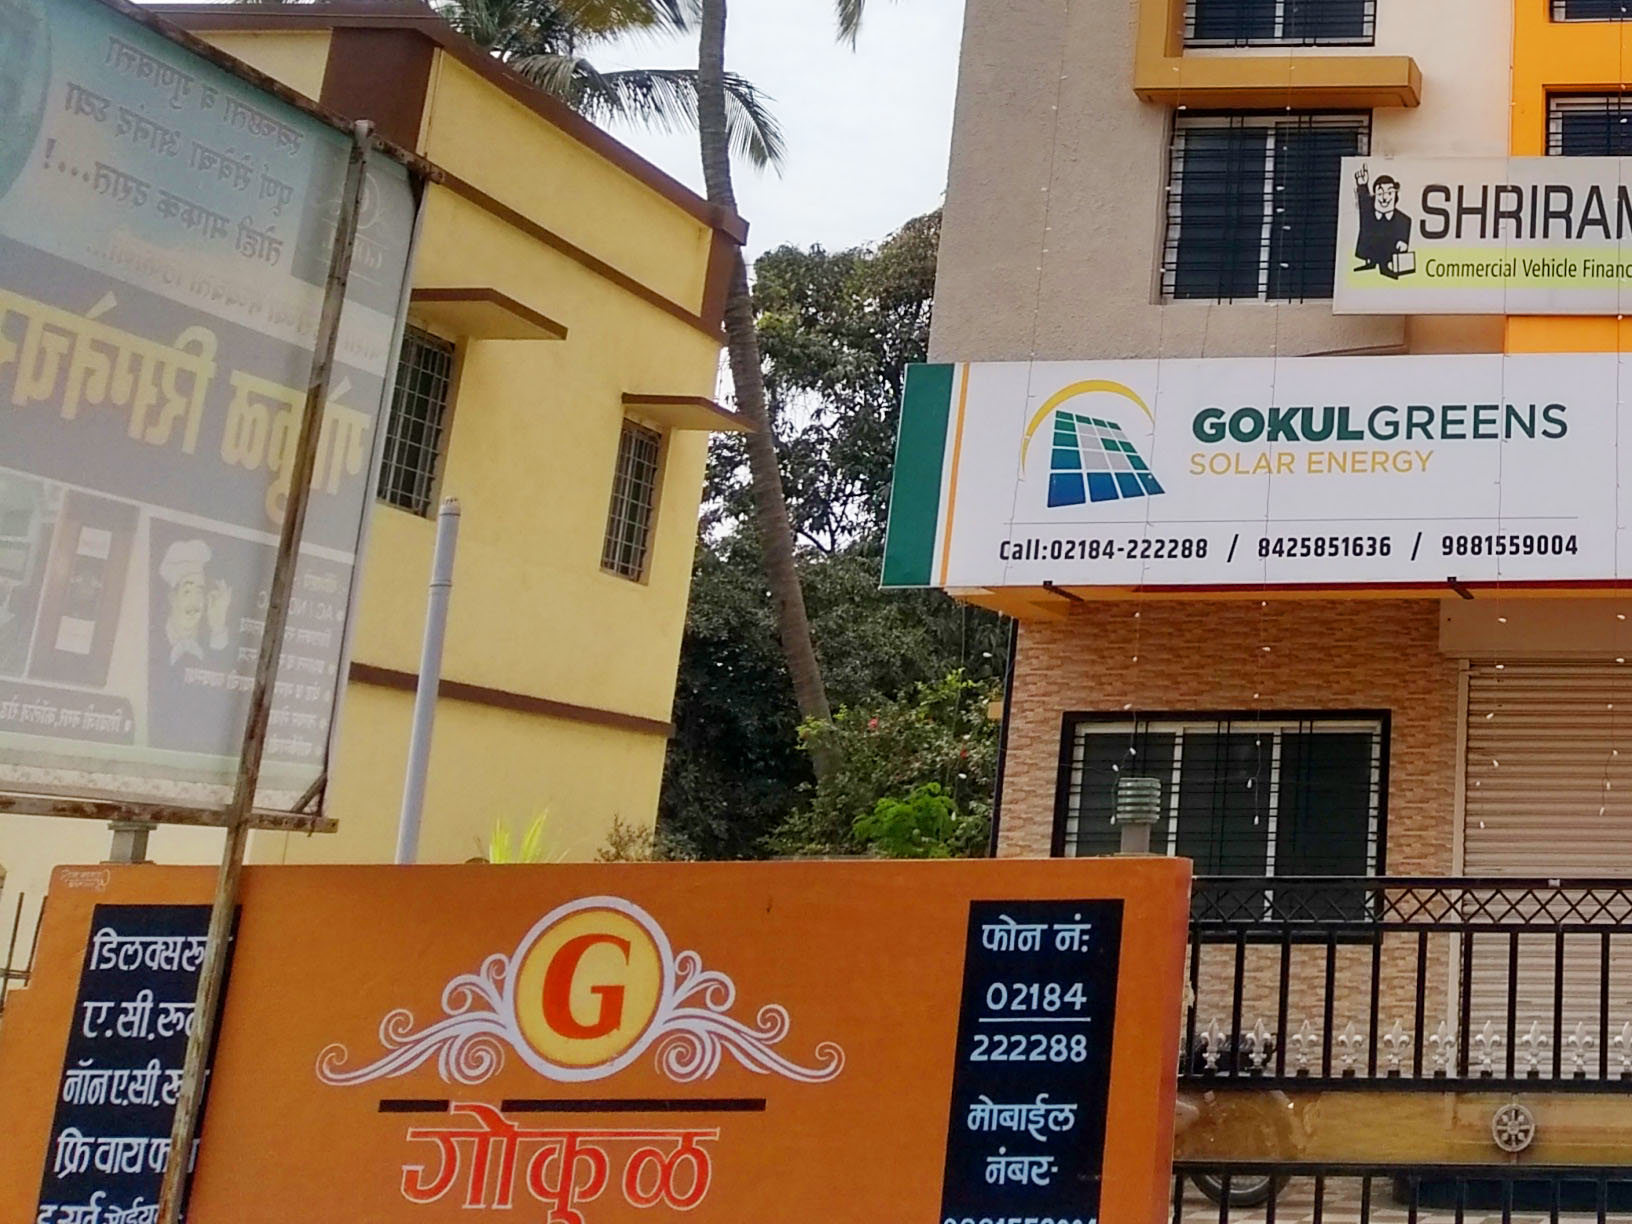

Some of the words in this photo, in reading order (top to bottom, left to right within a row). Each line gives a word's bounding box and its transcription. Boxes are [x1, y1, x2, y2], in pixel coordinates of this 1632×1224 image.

[1425, 257, 1516, 279] Commercial
[1522, 257, 1577, 279] Vehicle
[1191, 402, 1568, 444] GOKULGREENS
[1190, 451, 1296, 476] SOLAR
[1306, 449, 1434, 474] ENERGY
[1258, 535, 1392, 560] 8425851636
[1441, 533, 1579, 558] 9881559004
[981, 914, 1047, 954] फोन
[541, 933, 631, 1040] G
[986, 982, 1087, 1012] 02184
[969, 1033, 1088, 1063] 222288
[400, 1102, 721, 1224] गोकुळ
